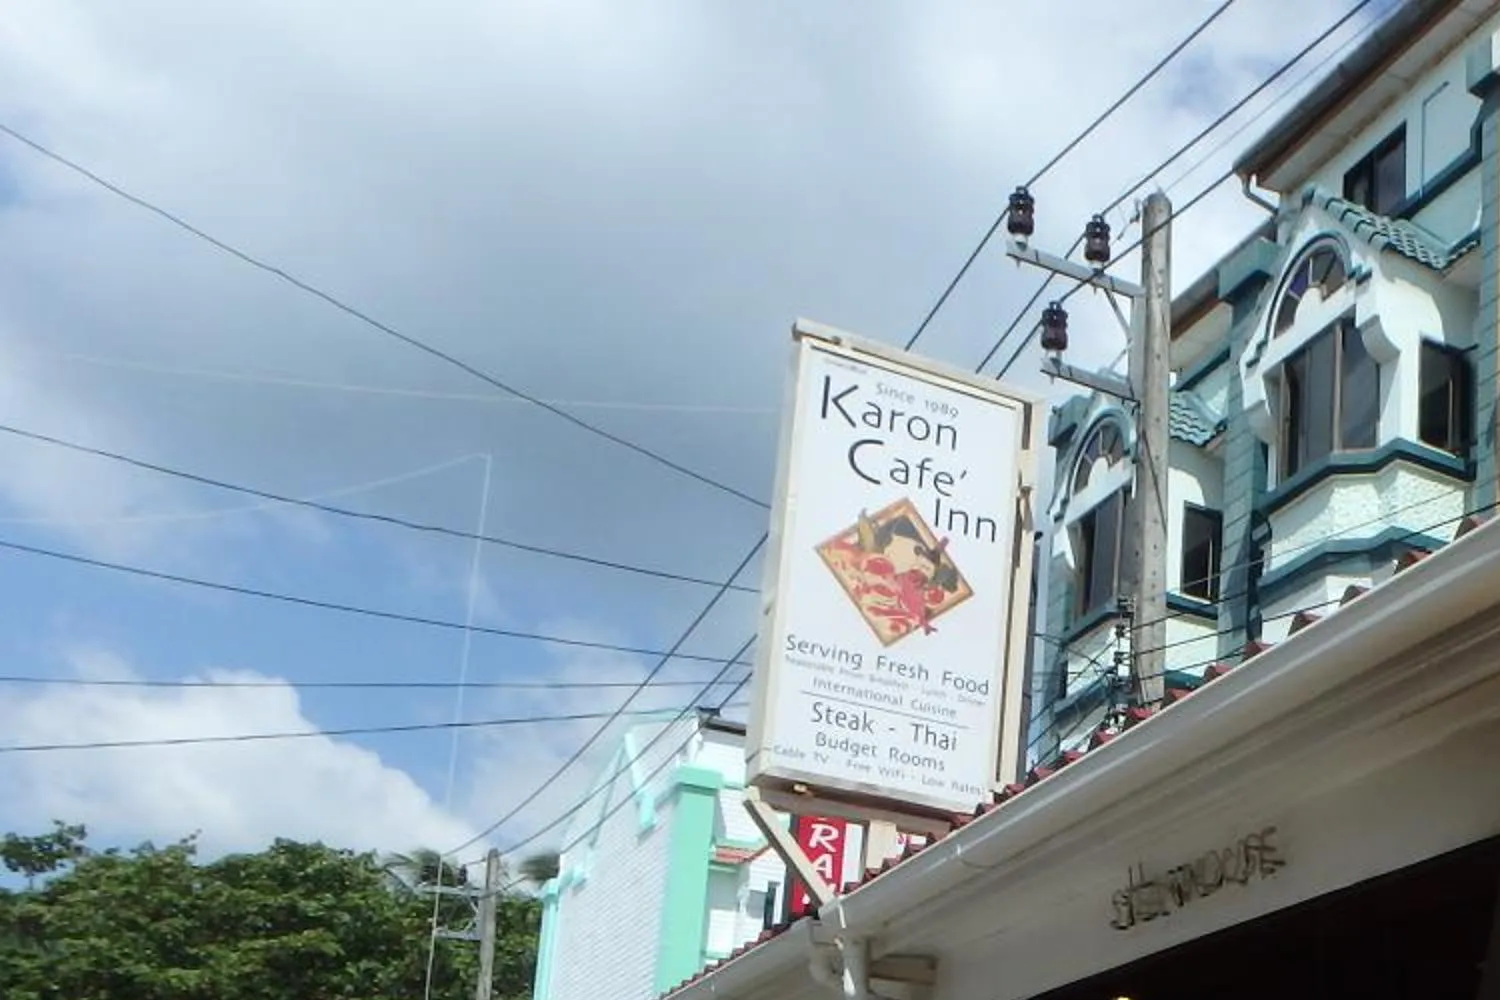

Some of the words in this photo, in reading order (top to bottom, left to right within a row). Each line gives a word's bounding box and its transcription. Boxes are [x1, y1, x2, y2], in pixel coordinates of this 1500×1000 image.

[821, 375, 958, 450] Karon
[876, 382, 915, 402] Since
[925, 399, 959, 418] 1989
[934, 498, 997, 543] Inn
[786, 634, 863, 671] Serving
[876, 655, 929, 681] Fresh
[942, 671, 989, 696] Food
[813, 677, 903, 705] International
[910, 698, 957, 717] Cuisine
[811, 701, 875, 734] Steak
[911, 723, 957, 751] Thai
[815, 732, 878, 760] Budget
[889, 748, 946, 771] Rooms
